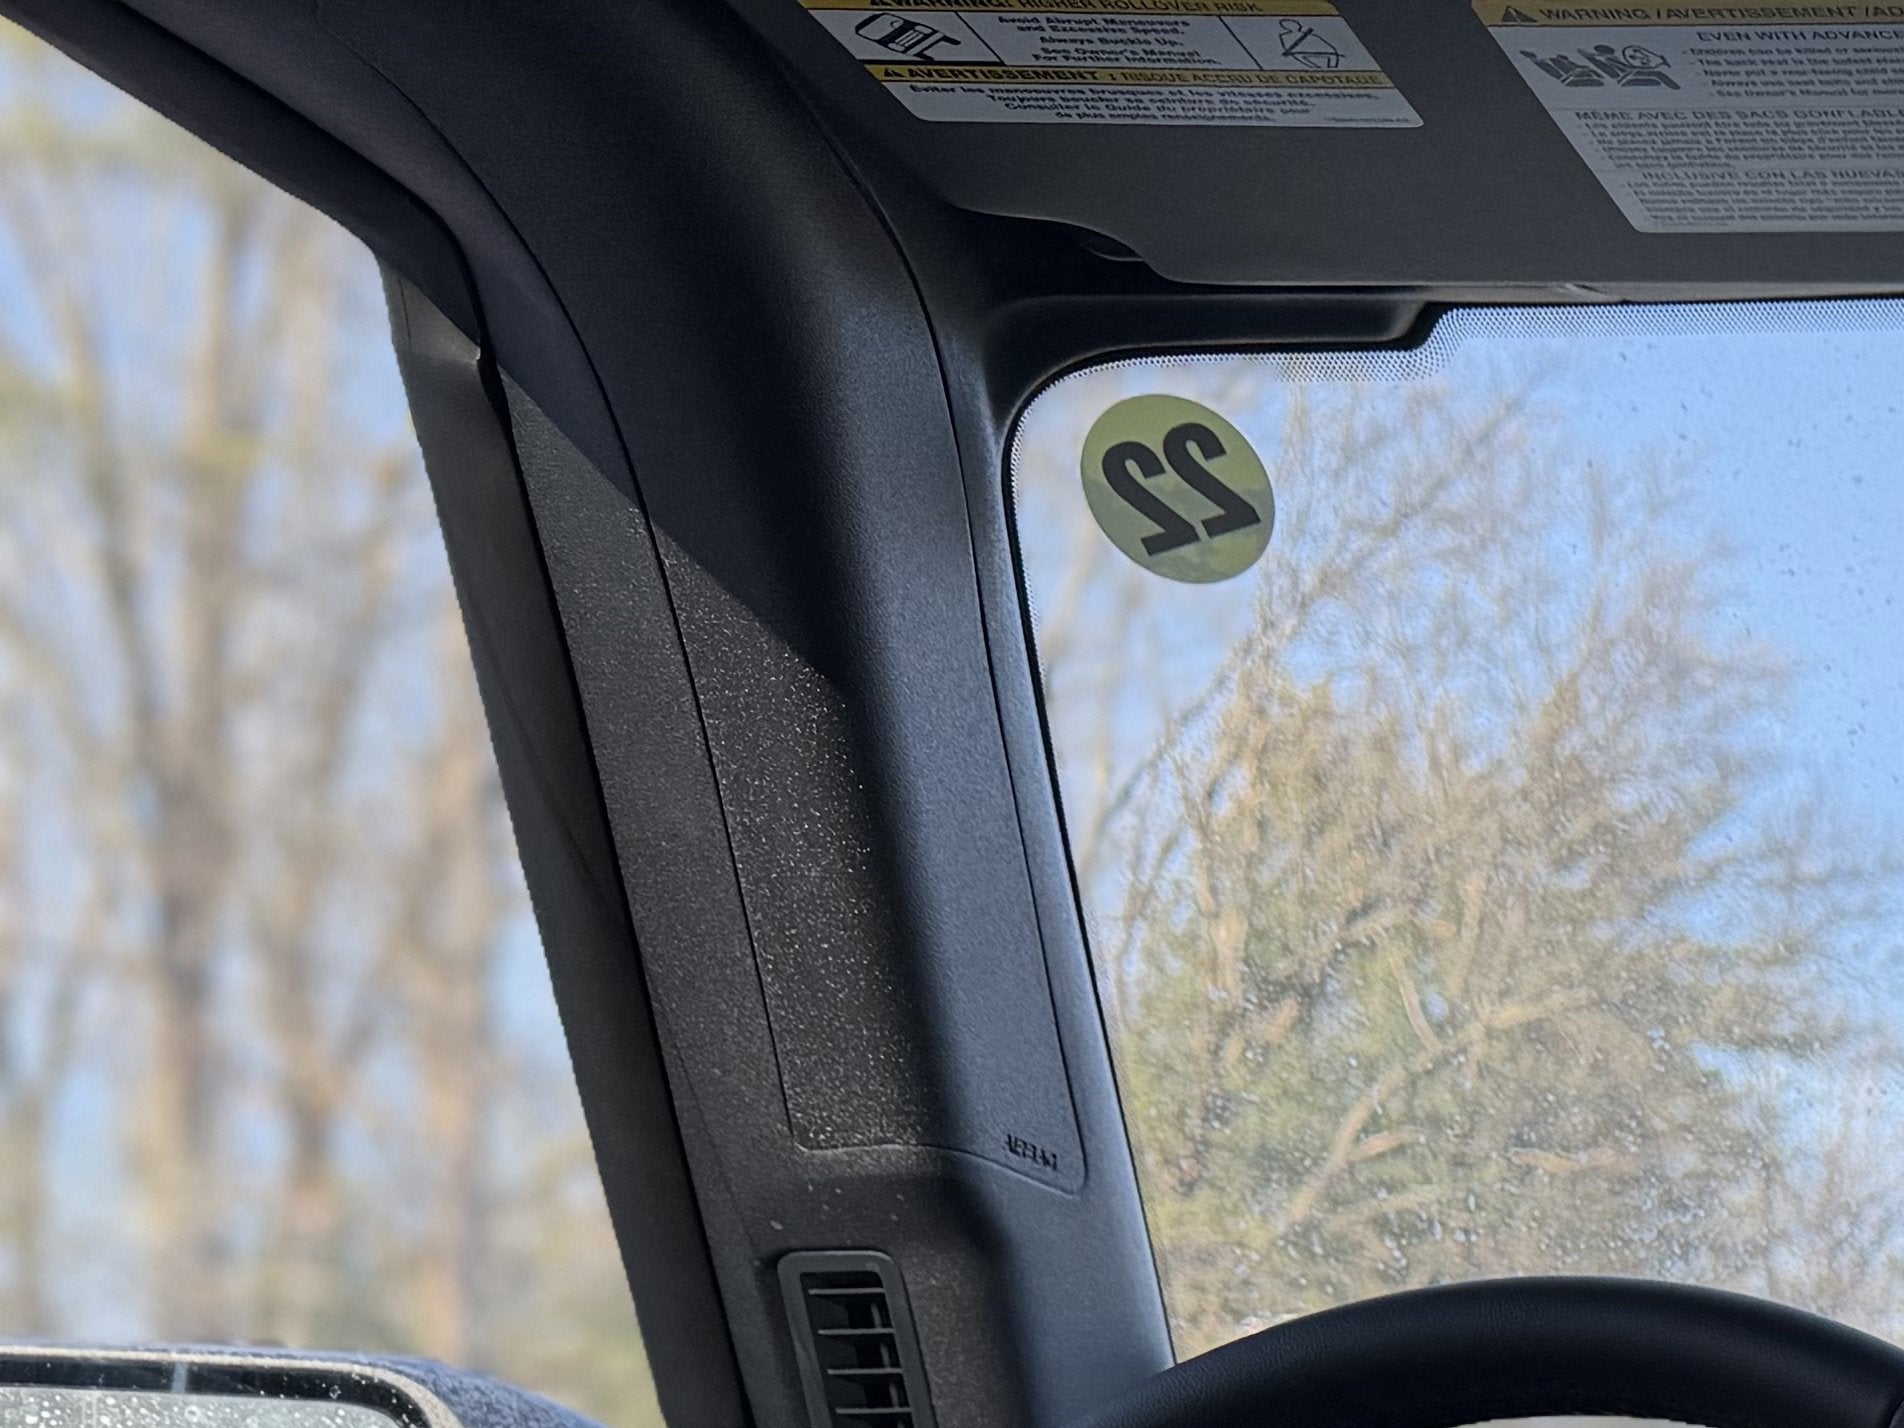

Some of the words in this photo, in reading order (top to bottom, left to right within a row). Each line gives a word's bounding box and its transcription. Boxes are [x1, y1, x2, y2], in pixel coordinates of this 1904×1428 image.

[1213, 2, 1264, 13] RISK
[1539, 8, 1651, 20] WARNING
[1696, 31, 1751, 42] EVEN
[1754, 30, 1808, 41] WITH
[907, 68, 1097, 81] AVERTISSEMENT
